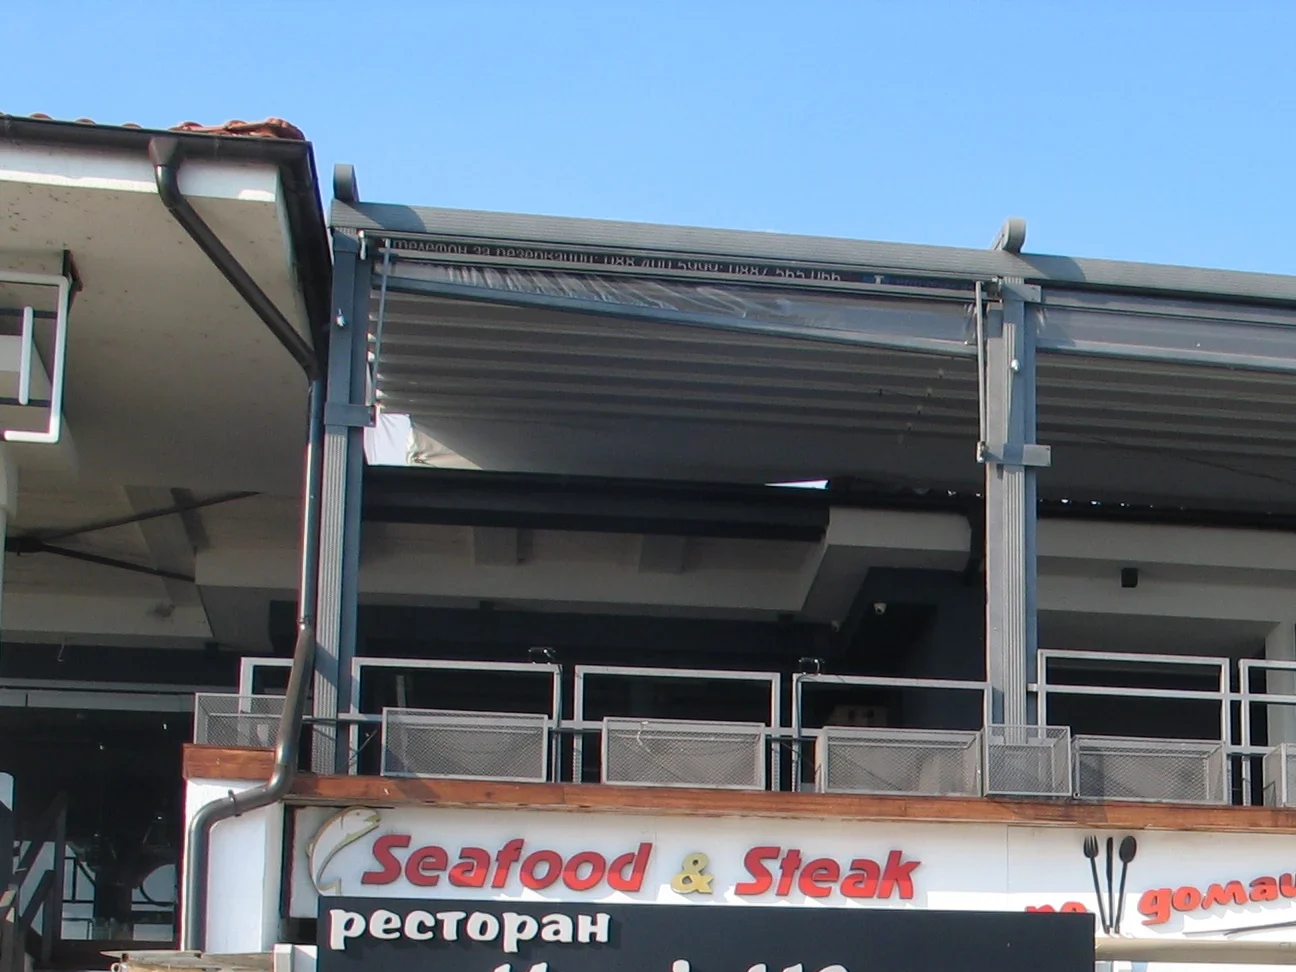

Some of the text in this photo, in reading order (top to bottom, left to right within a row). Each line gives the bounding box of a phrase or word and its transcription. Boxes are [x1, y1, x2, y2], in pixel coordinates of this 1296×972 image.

[361, 834, 922, 899] Seafood & Steak
[329, 908, 612, 952] ресторан
